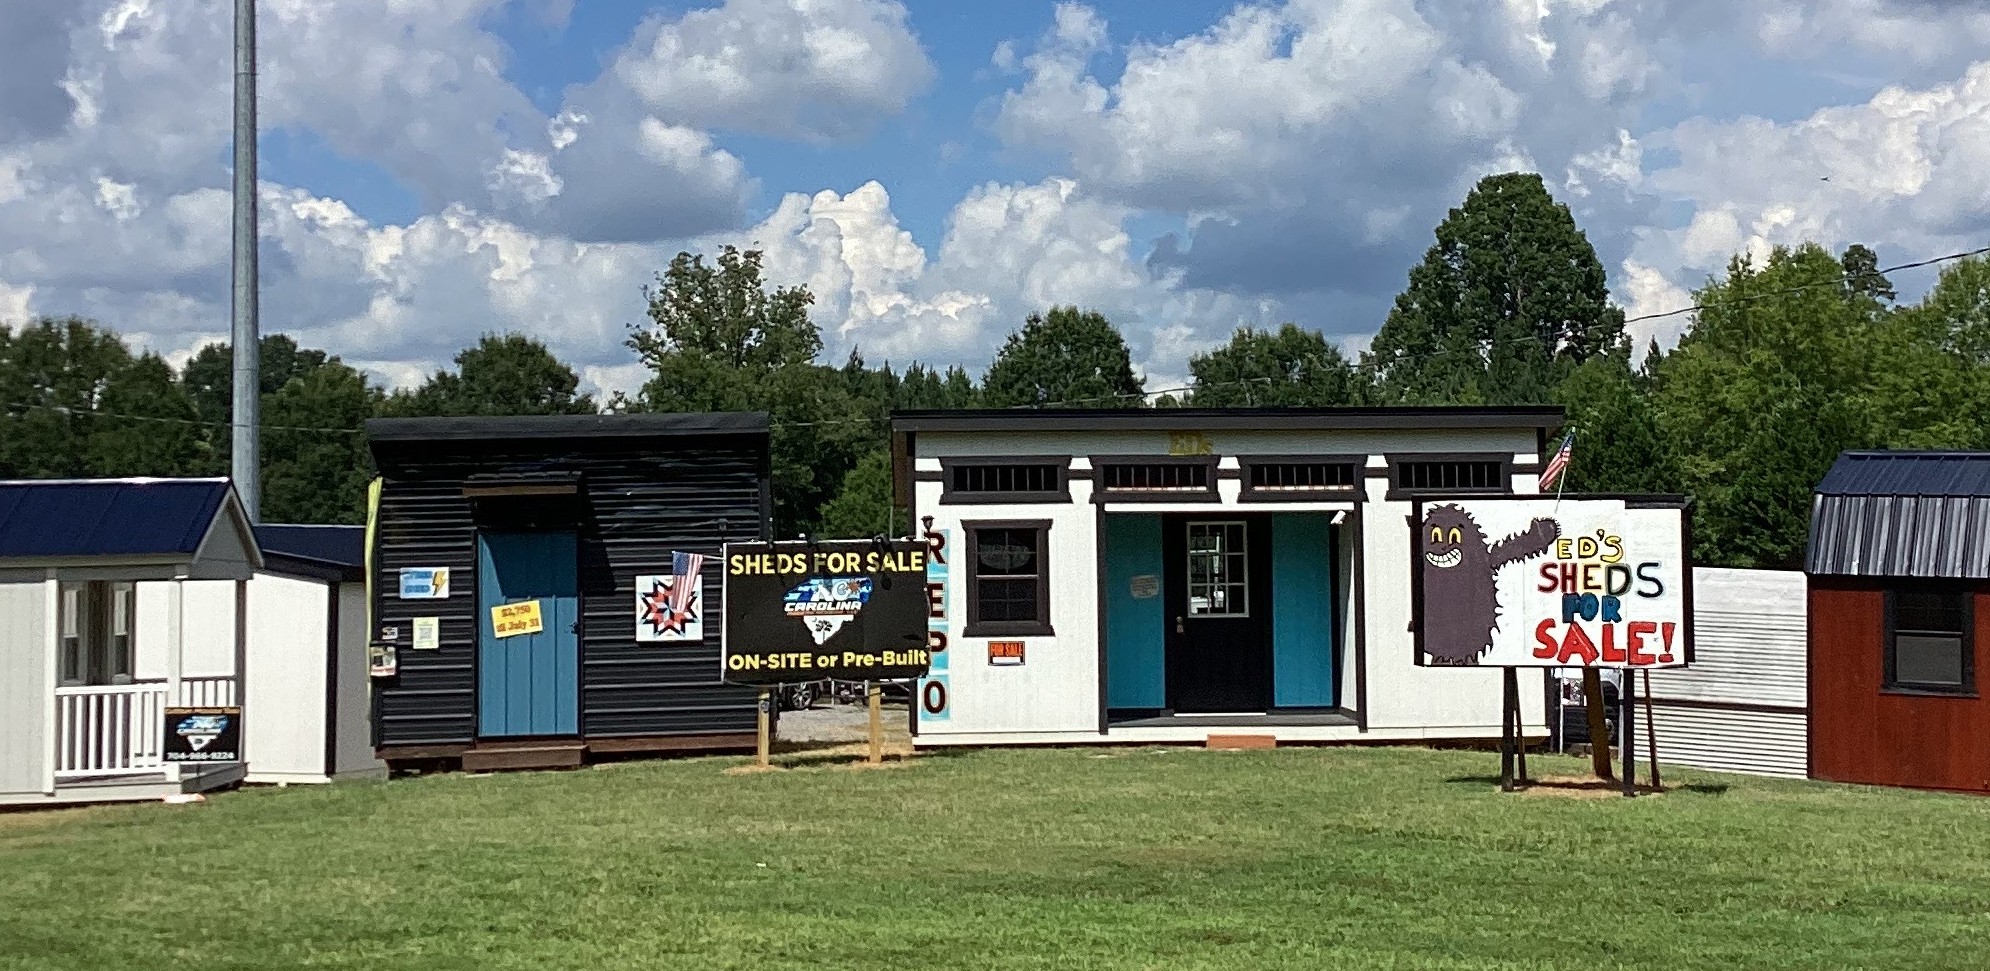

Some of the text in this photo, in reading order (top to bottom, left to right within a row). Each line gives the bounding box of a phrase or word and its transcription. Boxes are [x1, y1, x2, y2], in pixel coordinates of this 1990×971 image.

[1556, 528, 1624, 563] ED'S
[730, 551, 924, 575] SHEDS FOR SALE
[1537, 561, 1665, 598] SHEDS
[784, 600, 862, 612] CAROLINA
[1562, 592, 1622, 623] FOR
[990, 643, 1023, 656] FOR SALE
[1532, 618, 1676, 666] SALE!
[729, 649, 927, 670] ON-SITE or Pre-Built
